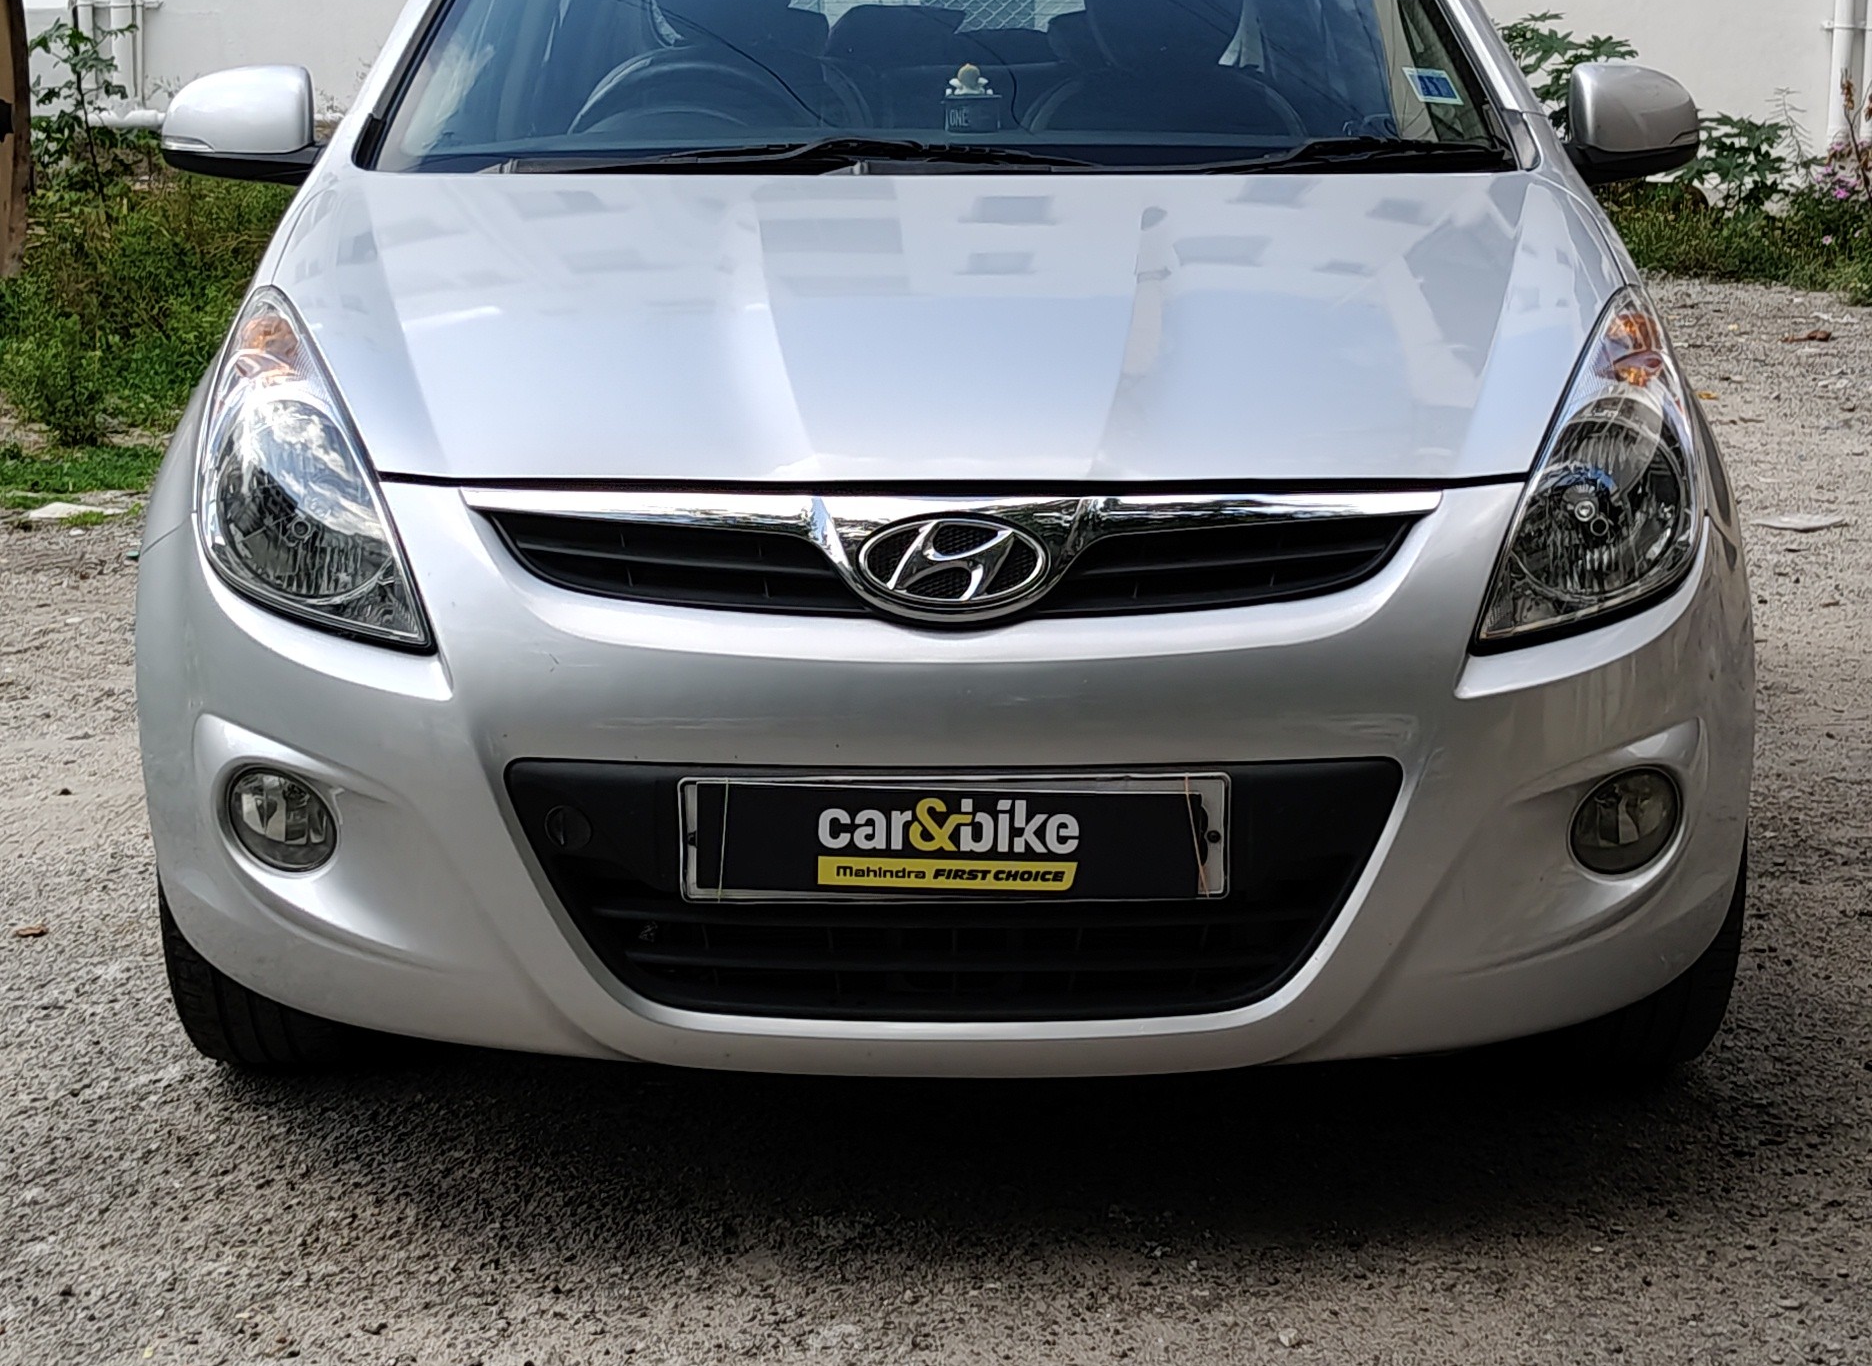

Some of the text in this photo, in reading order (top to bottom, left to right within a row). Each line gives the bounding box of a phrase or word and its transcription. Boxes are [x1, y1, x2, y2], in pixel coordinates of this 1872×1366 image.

[818, 797, 1080, 854] car&bike
[836, 865, 1066, 882] Mahindra FIRST CHOICE
